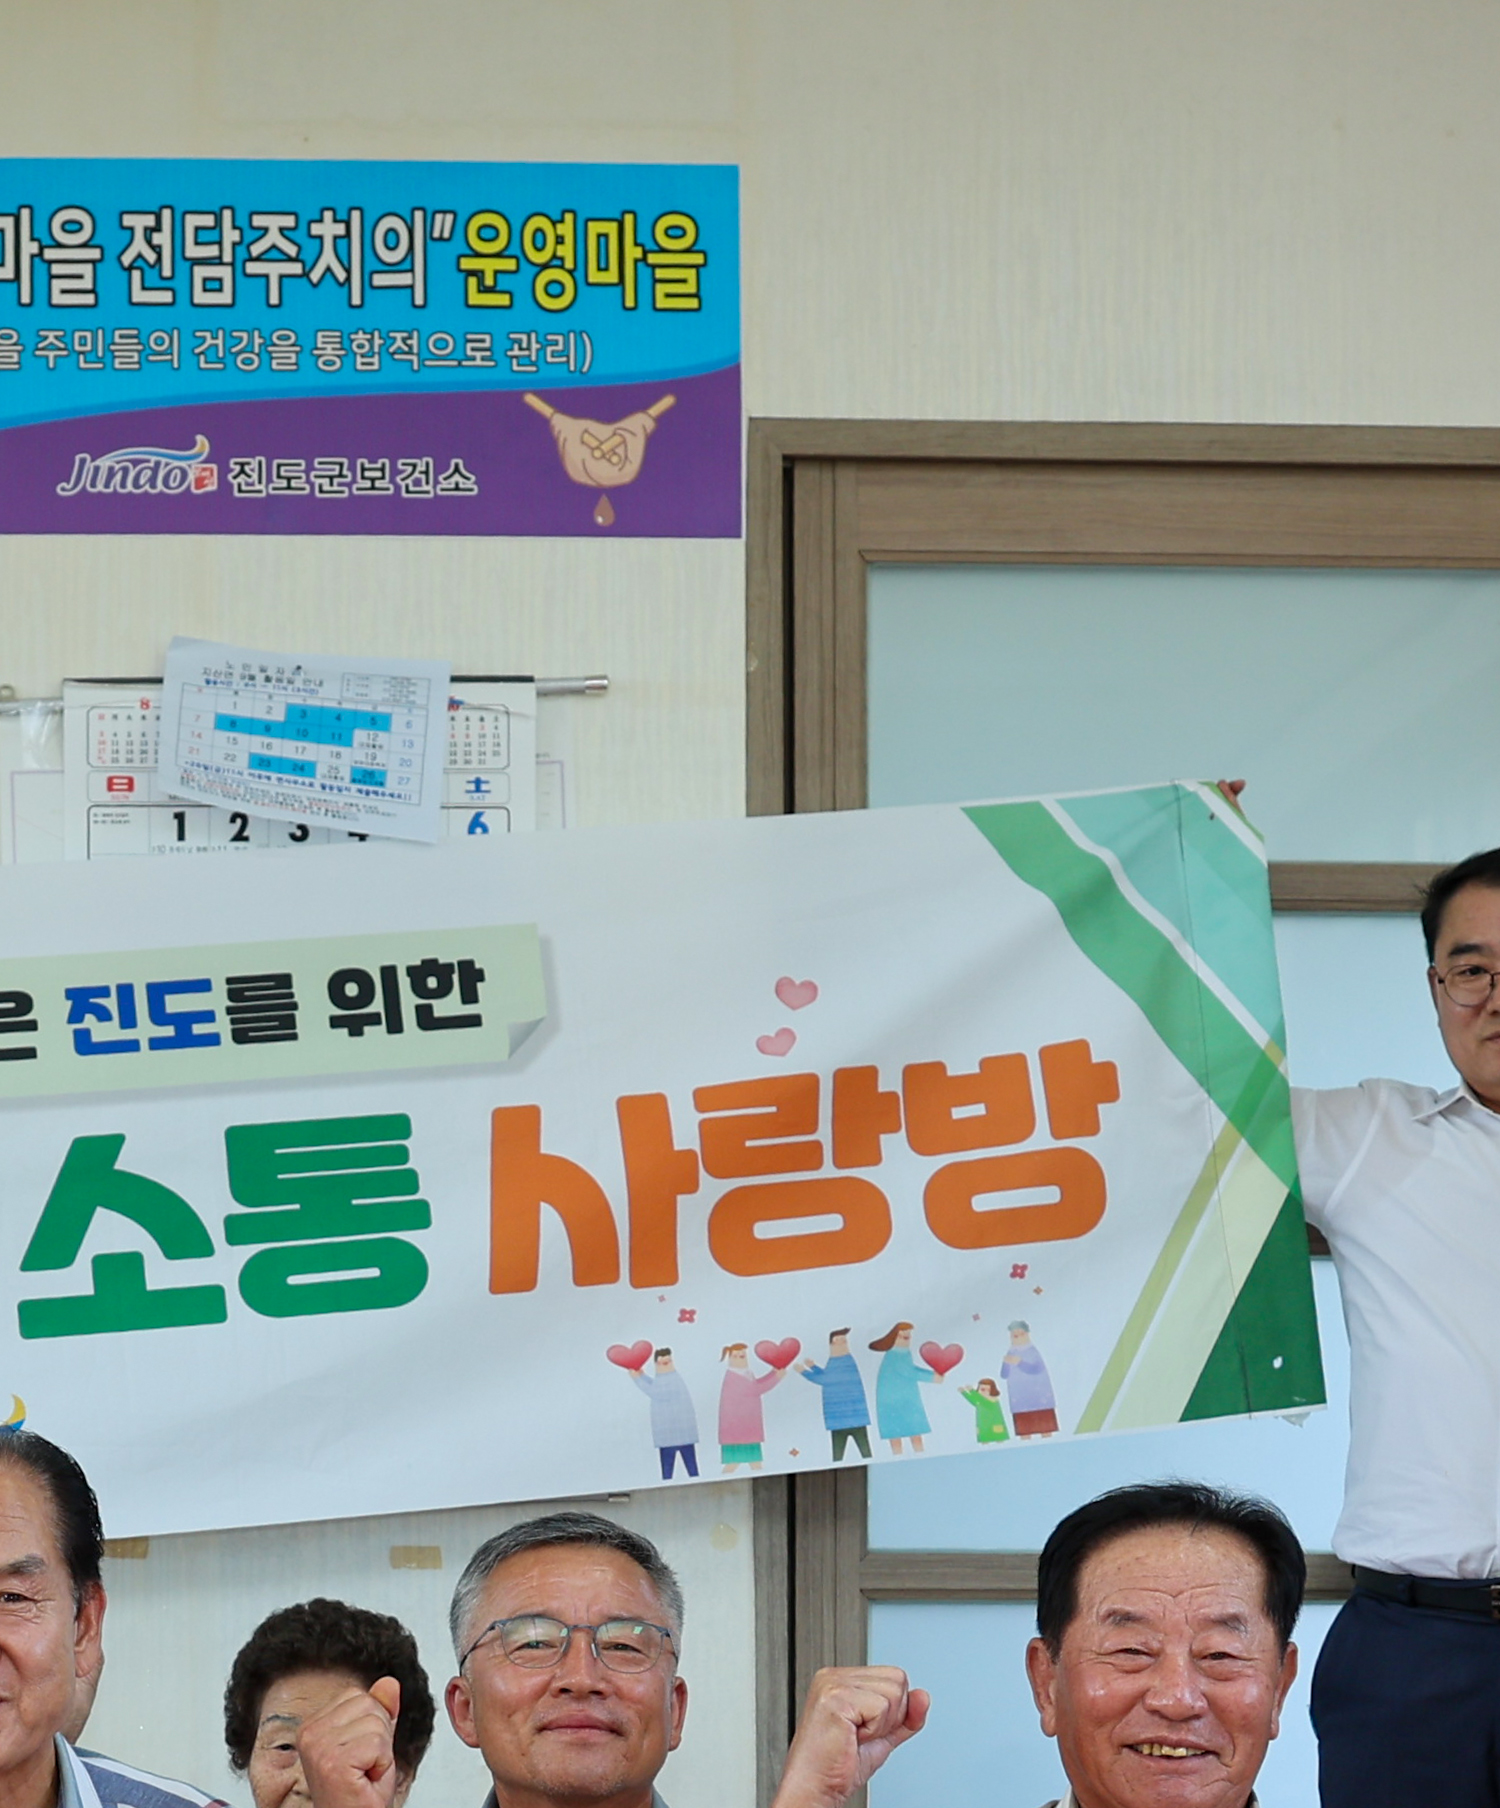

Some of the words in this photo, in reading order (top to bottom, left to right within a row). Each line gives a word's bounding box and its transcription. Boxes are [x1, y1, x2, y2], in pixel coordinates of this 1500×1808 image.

[35, 328, 181, 372] 주민들의
[192, 328, 301, 372] 건강을
[312, 329, 497, 373] 통합적으로
[506, 330, 595, 374] 관리)
[56, 453, 192, 495] Jindo
[227, 456, 478, 500] 진도군보건소
[465, 777, 490, 794] 土
[173, 811, 186, 841] 1
[229, 812, 250, 842] 2
[468, 811, 489, 835] 6
[64, 972, 300, 1056] 진도를
[327, 957, 486, 1039] 위한
[16, 1112, 432, 1342] 소통
[489, 1036, 1121, 1294] 사랑방
